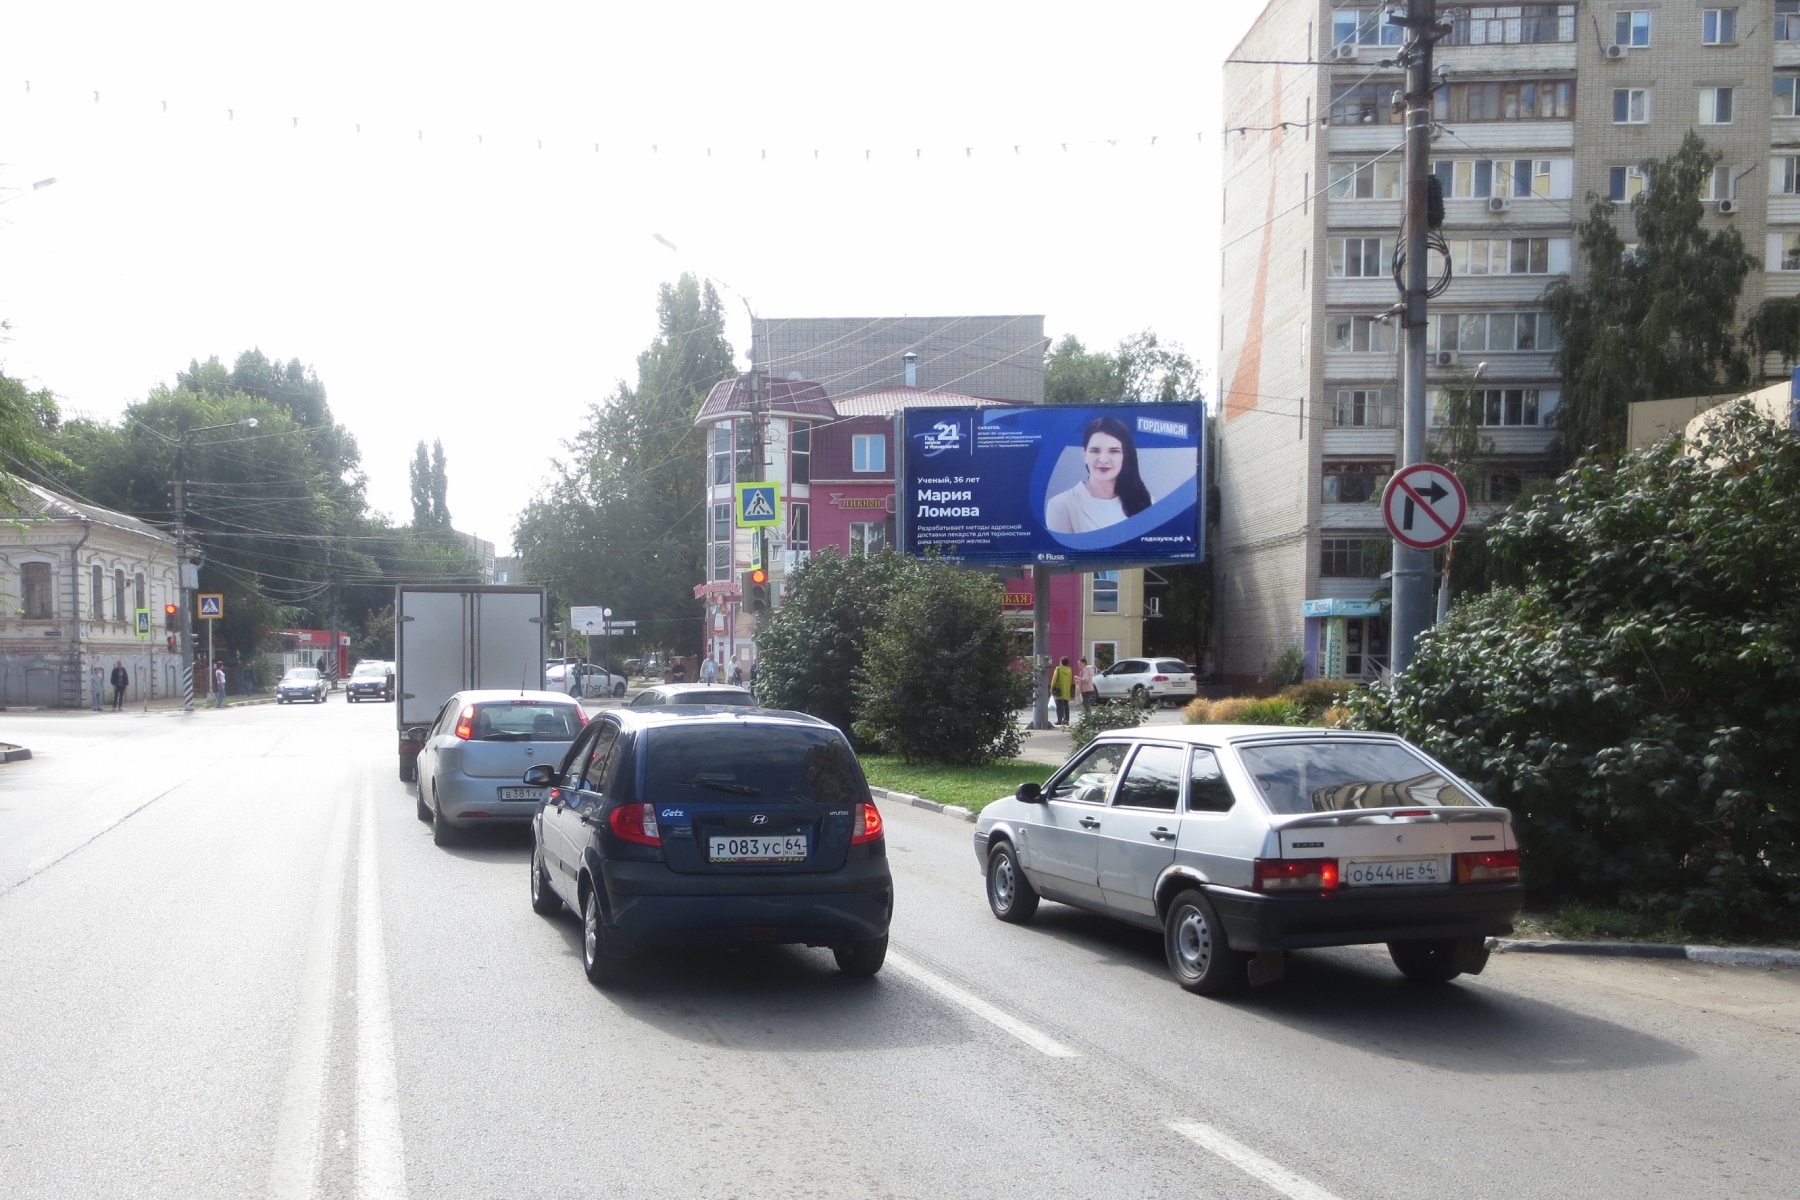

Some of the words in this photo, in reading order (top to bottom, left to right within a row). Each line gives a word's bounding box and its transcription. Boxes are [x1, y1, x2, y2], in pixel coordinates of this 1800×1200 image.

[1138, 418, 1186, 436] ГОРДИМСЯ!
[917, 489, 972, 504] Мария
[917, 505, 980, 518] Ломова
[917, 524, 965, 532] Разрабатывает
[990, 523, 1022, 531] адресной
[1045, 553, 1065, 561] Russ
[661, 808, 684, 817] Getz
